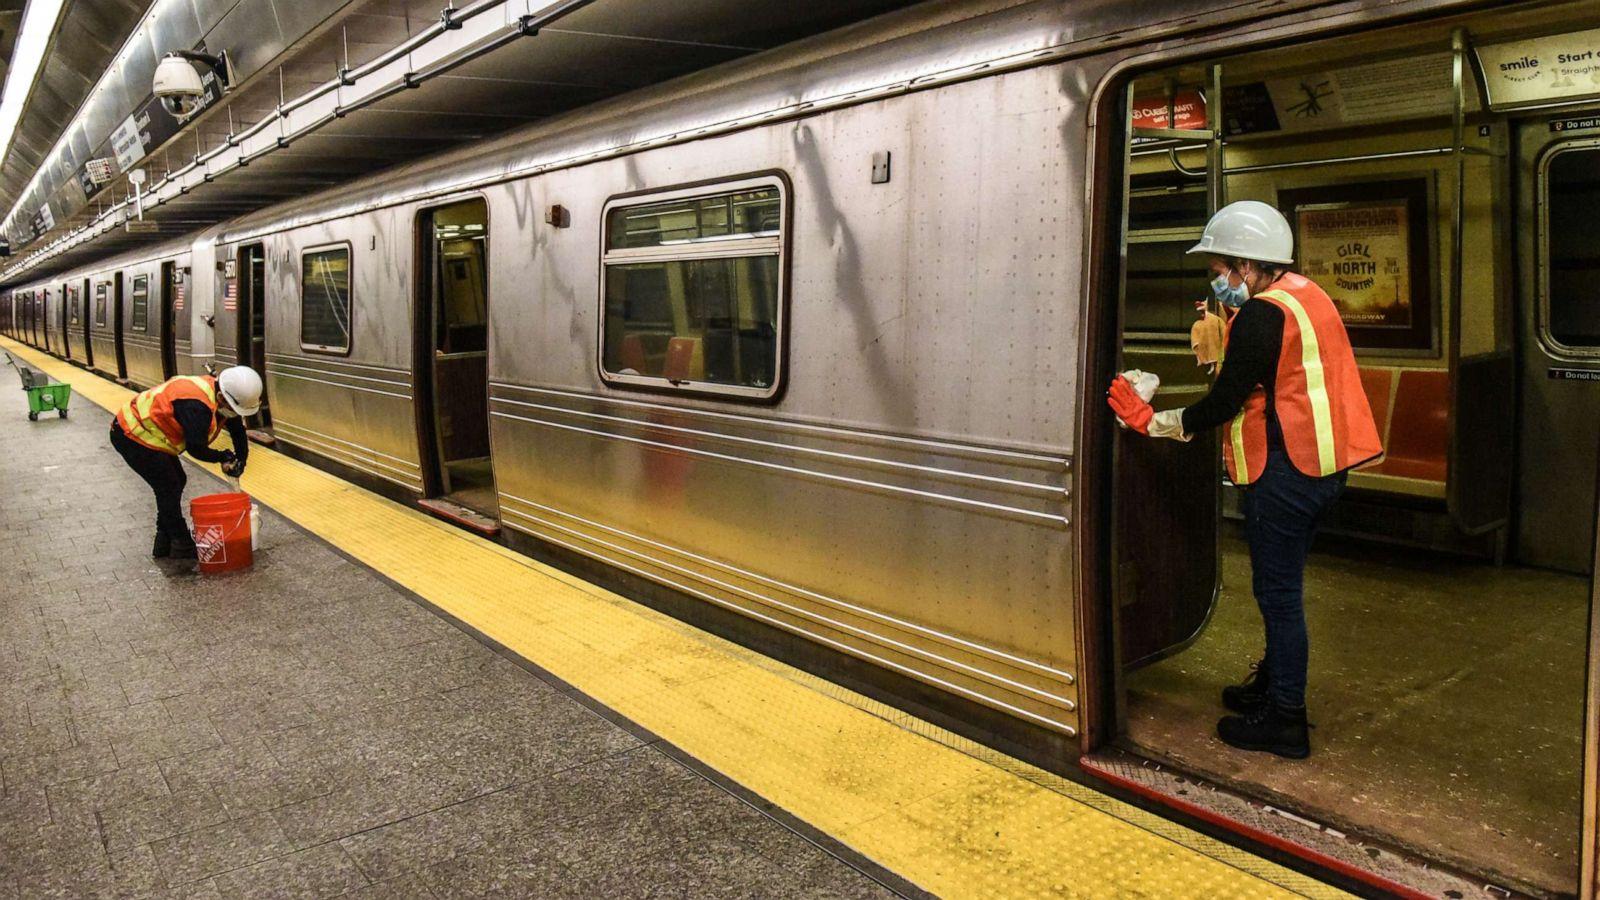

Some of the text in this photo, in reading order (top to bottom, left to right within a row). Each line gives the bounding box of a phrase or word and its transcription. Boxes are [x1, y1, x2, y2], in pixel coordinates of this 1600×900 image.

[1499, 56, 1539, 72] smile
[1557, 50, 1593, 64] Start
[1566, 121, 1579, 129] Do
[1580, 119, 1594, 128] not
[1336, 243, 1372, 259] GIRL
[1333, 261, 1377, 275] NORTH
[1335, 276, 1375, 292] COUNTRY
[1565, 371, 1577, 379] Do
[1577, 372, 1590, 380] not
